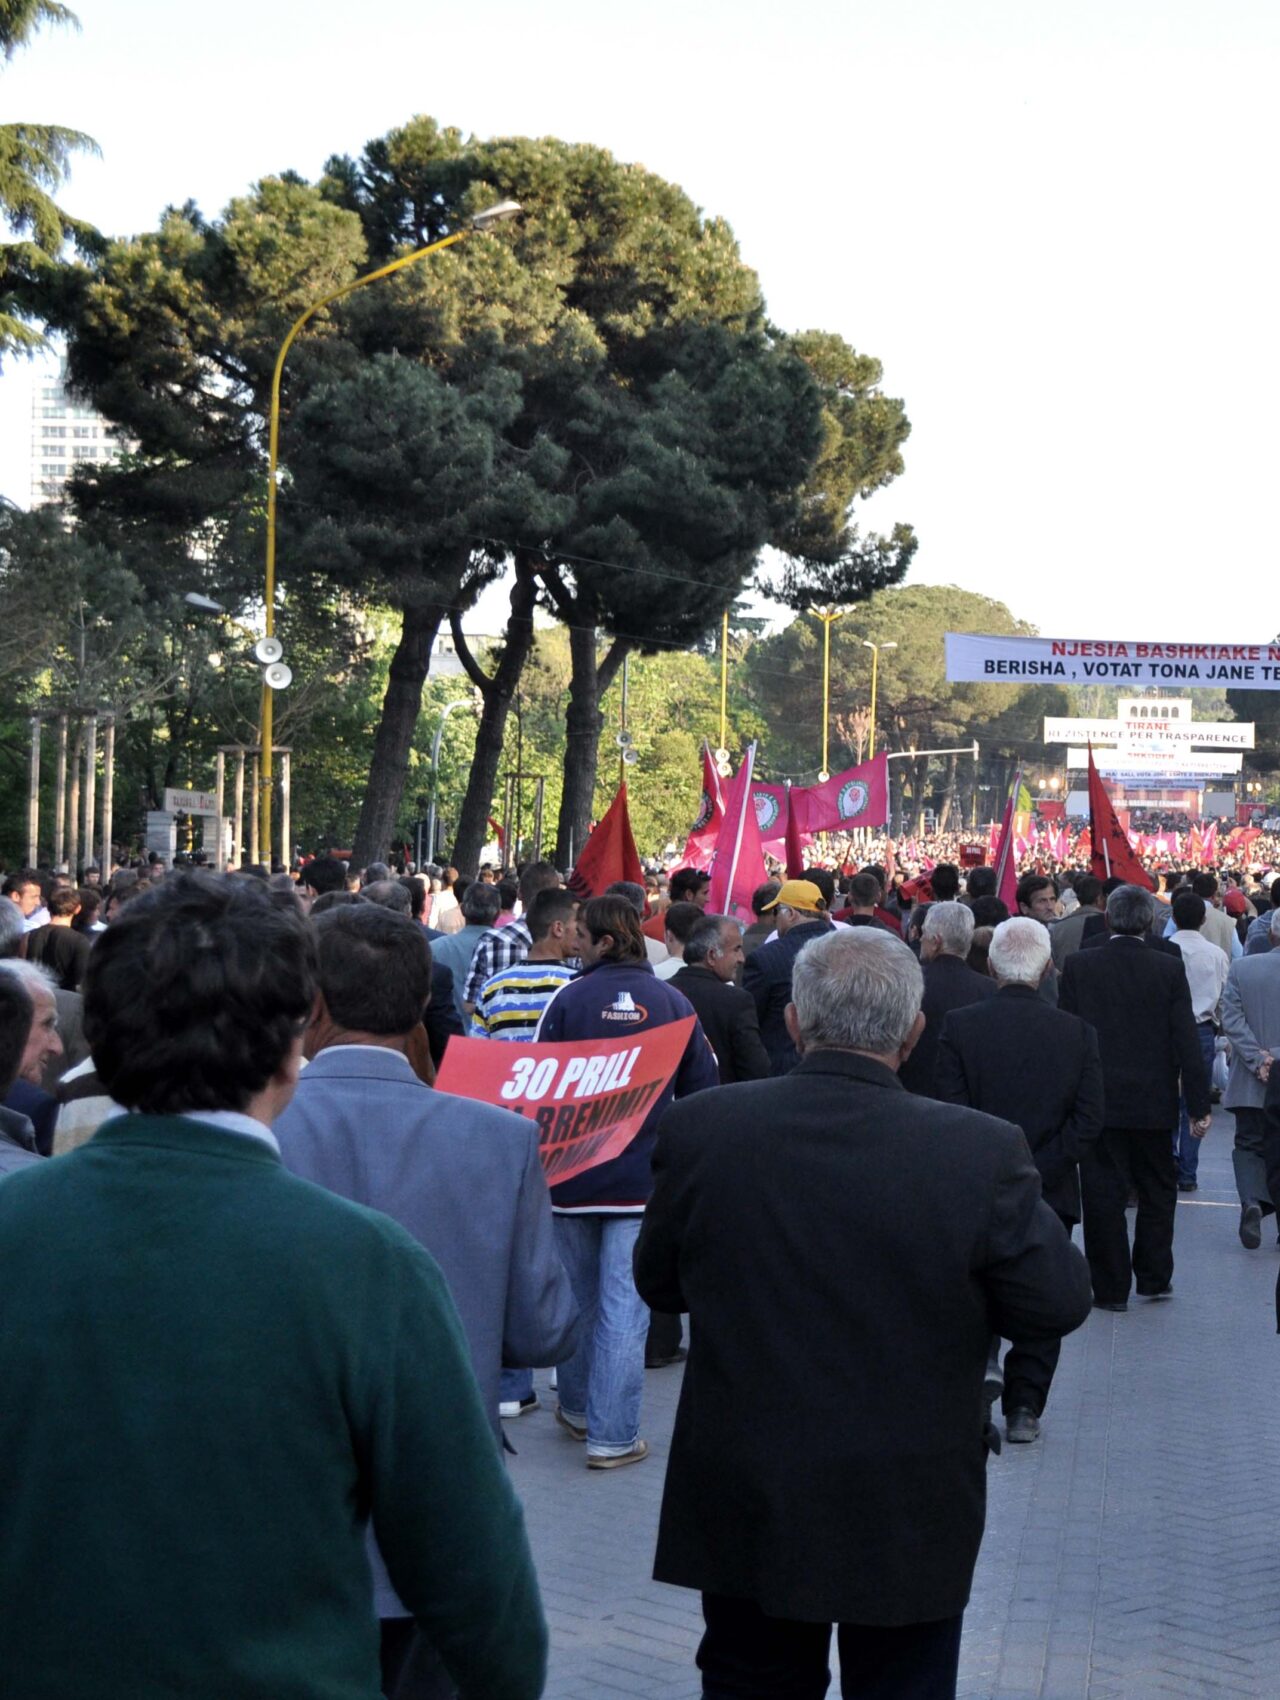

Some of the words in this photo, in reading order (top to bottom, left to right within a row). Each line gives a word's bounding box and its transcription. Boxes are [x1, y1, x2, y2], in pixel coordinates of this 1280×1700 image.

[1052, 641, 1128, 657] NJESIA
[1136, 644, 1260, 660] BASHKIAKE
[984, 660, 1065, 675] BERISHA
[1083, 662, 1142, 677] VOTAT
[1149, 663, 1199, 678] TONA
[1206, 665, 1254, 680] JANE
[1125, 722, 1171, 731] TIRANE
[1130, 731, 1153, 740] PER
[1159, 732, 1248, 743] TRASPARENCE
[602, 1010, 641, 1021] FASHION
[500, 1056, 559, 1101] 30
[553, 1045, 642, 1099] PRILL
